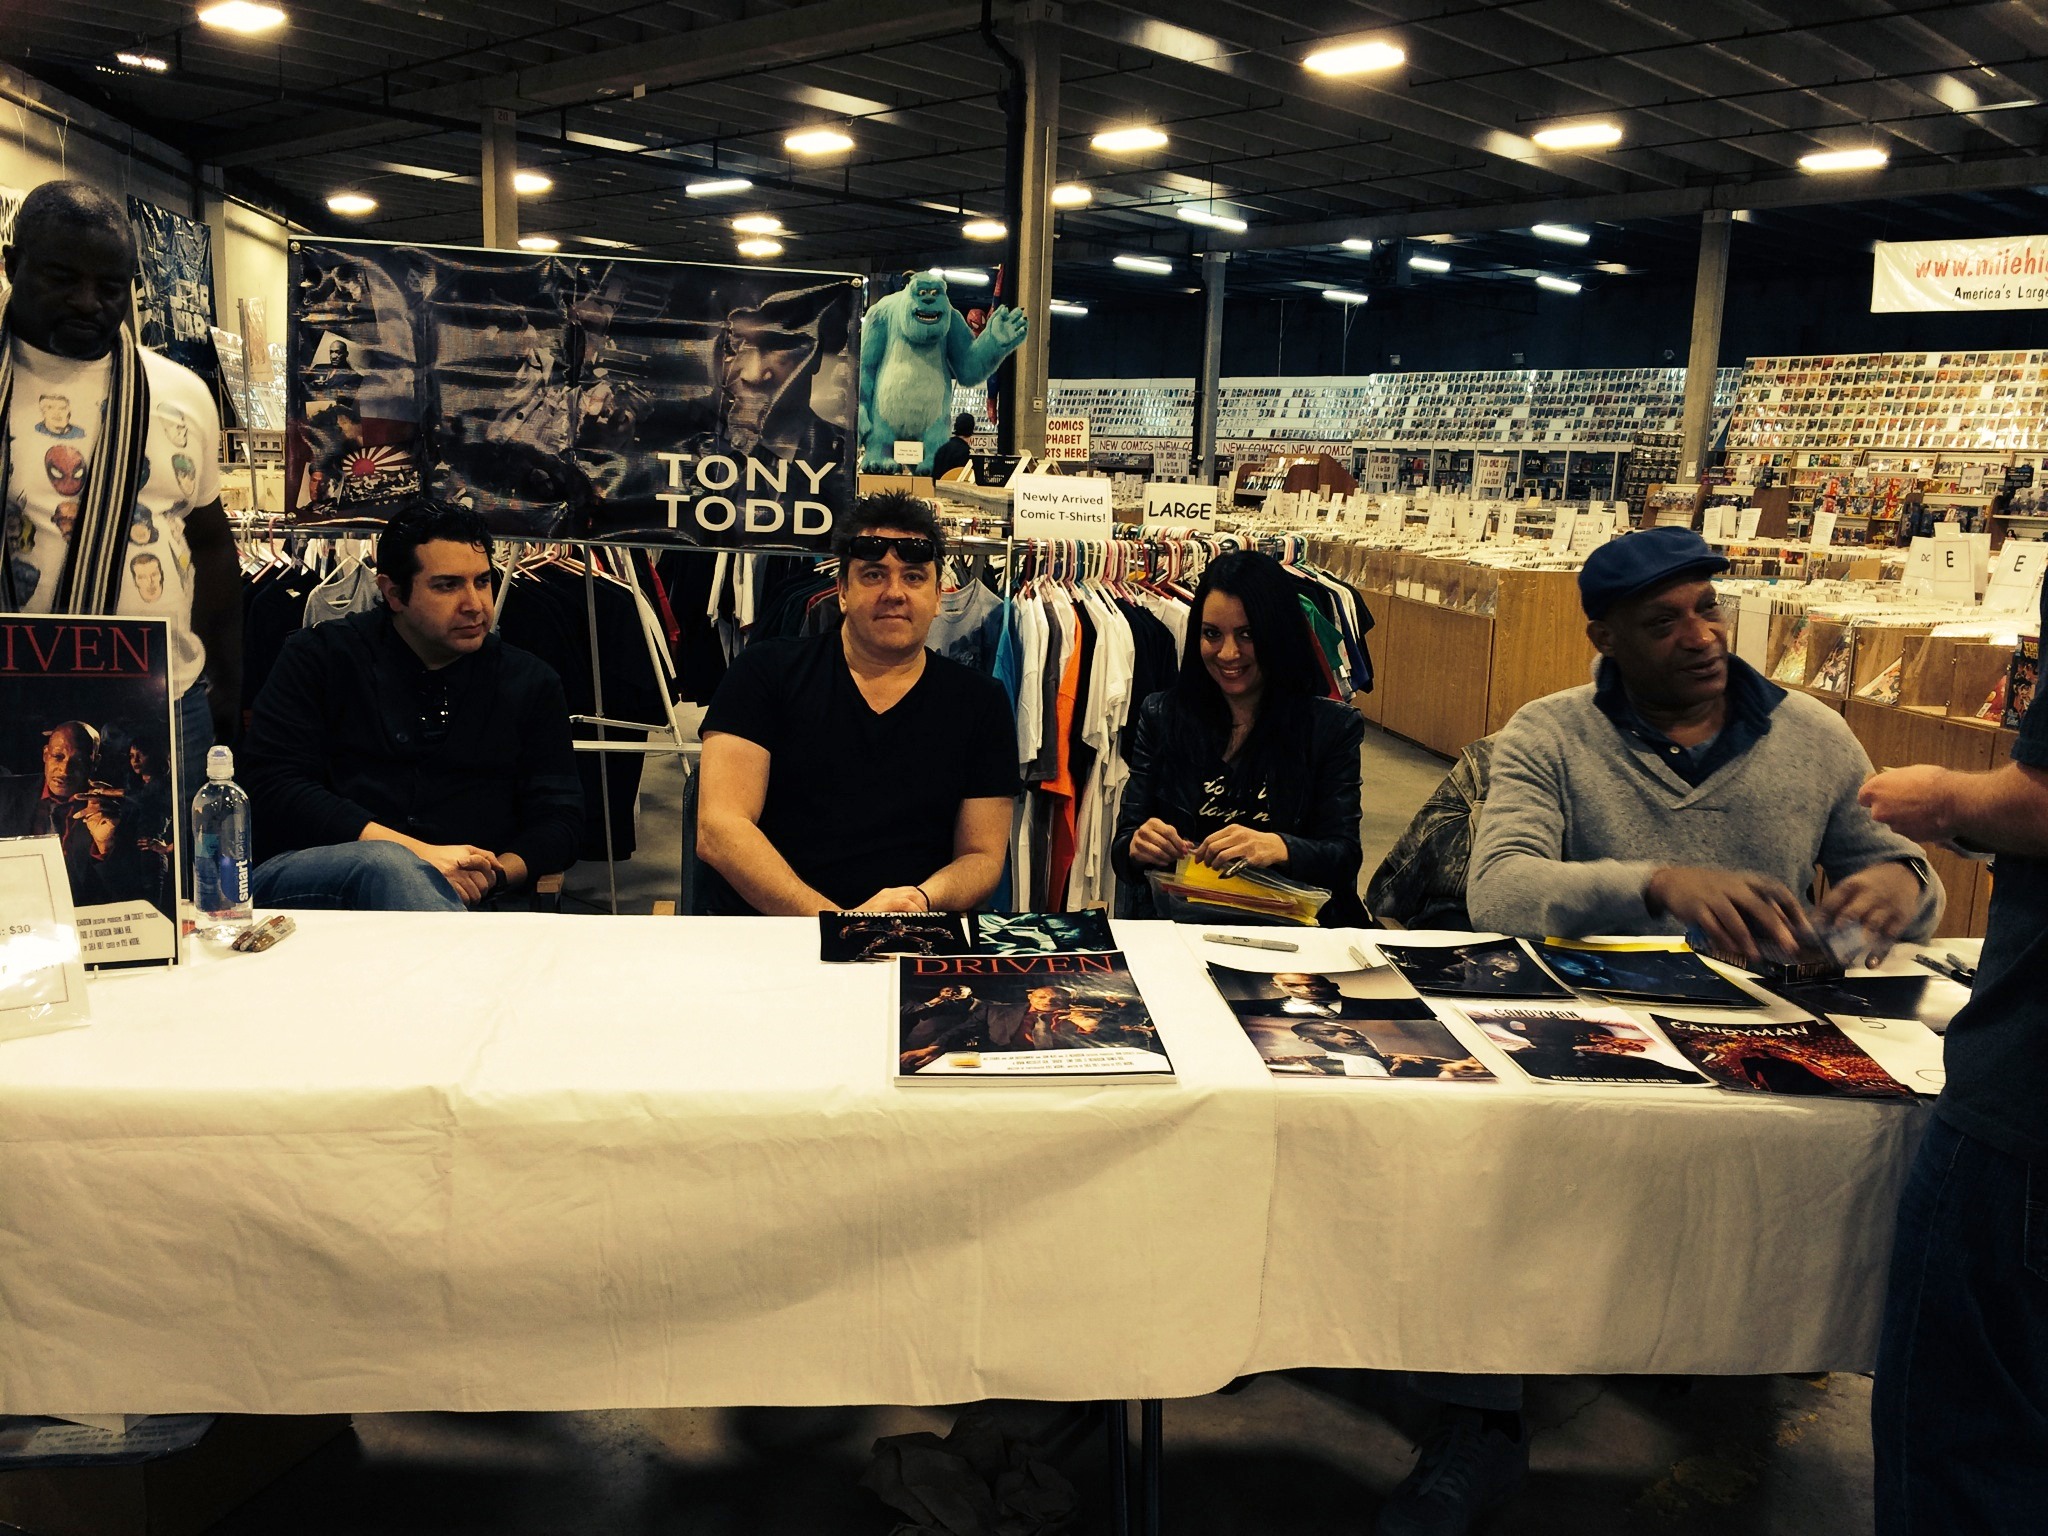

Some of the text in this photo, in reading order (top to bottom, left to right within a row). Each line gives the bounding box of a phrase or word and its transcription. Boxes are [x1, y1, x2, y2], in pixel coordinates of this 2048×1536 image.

[1954, 284, 2011, 299] America's
[1048, 420, 1084, 431] COMICS
[969, 437, 987, 447] MICS
[1046, 434, 1081, 445] PHABET
[1100, 440, 1119, 450] NEW
[1121, 441, 1154, 451] COMICS
[1159, 441, 1180, 451] NEW
[1045, 447, 1087, 459] RTS HERE
[1222, 443, 1245, 453] NEW
[1248, 443, 1286, 454] COMICS
[657, 453, 837, 494] TONY
[1022, 492, 1103, 505] Newly Arrived
[655, 494, 833, 535] TODD
[1020, 509, 1106, 522] Comic T-Shirts!
[1148, 500, 1212, 520] LARGE
[1946, 550, 1954, 568] E
[2013, 554, 2027, 572] E
[1, 625, 152, 672] IVEN
[9, 924, 31, 935] $30
[915, 954, 1114, 975] DRIVEN
[1493, 1008, 1580, 1019] CANDYMAN
[1669, 1020, 1809, 1037] CANDYMAN
